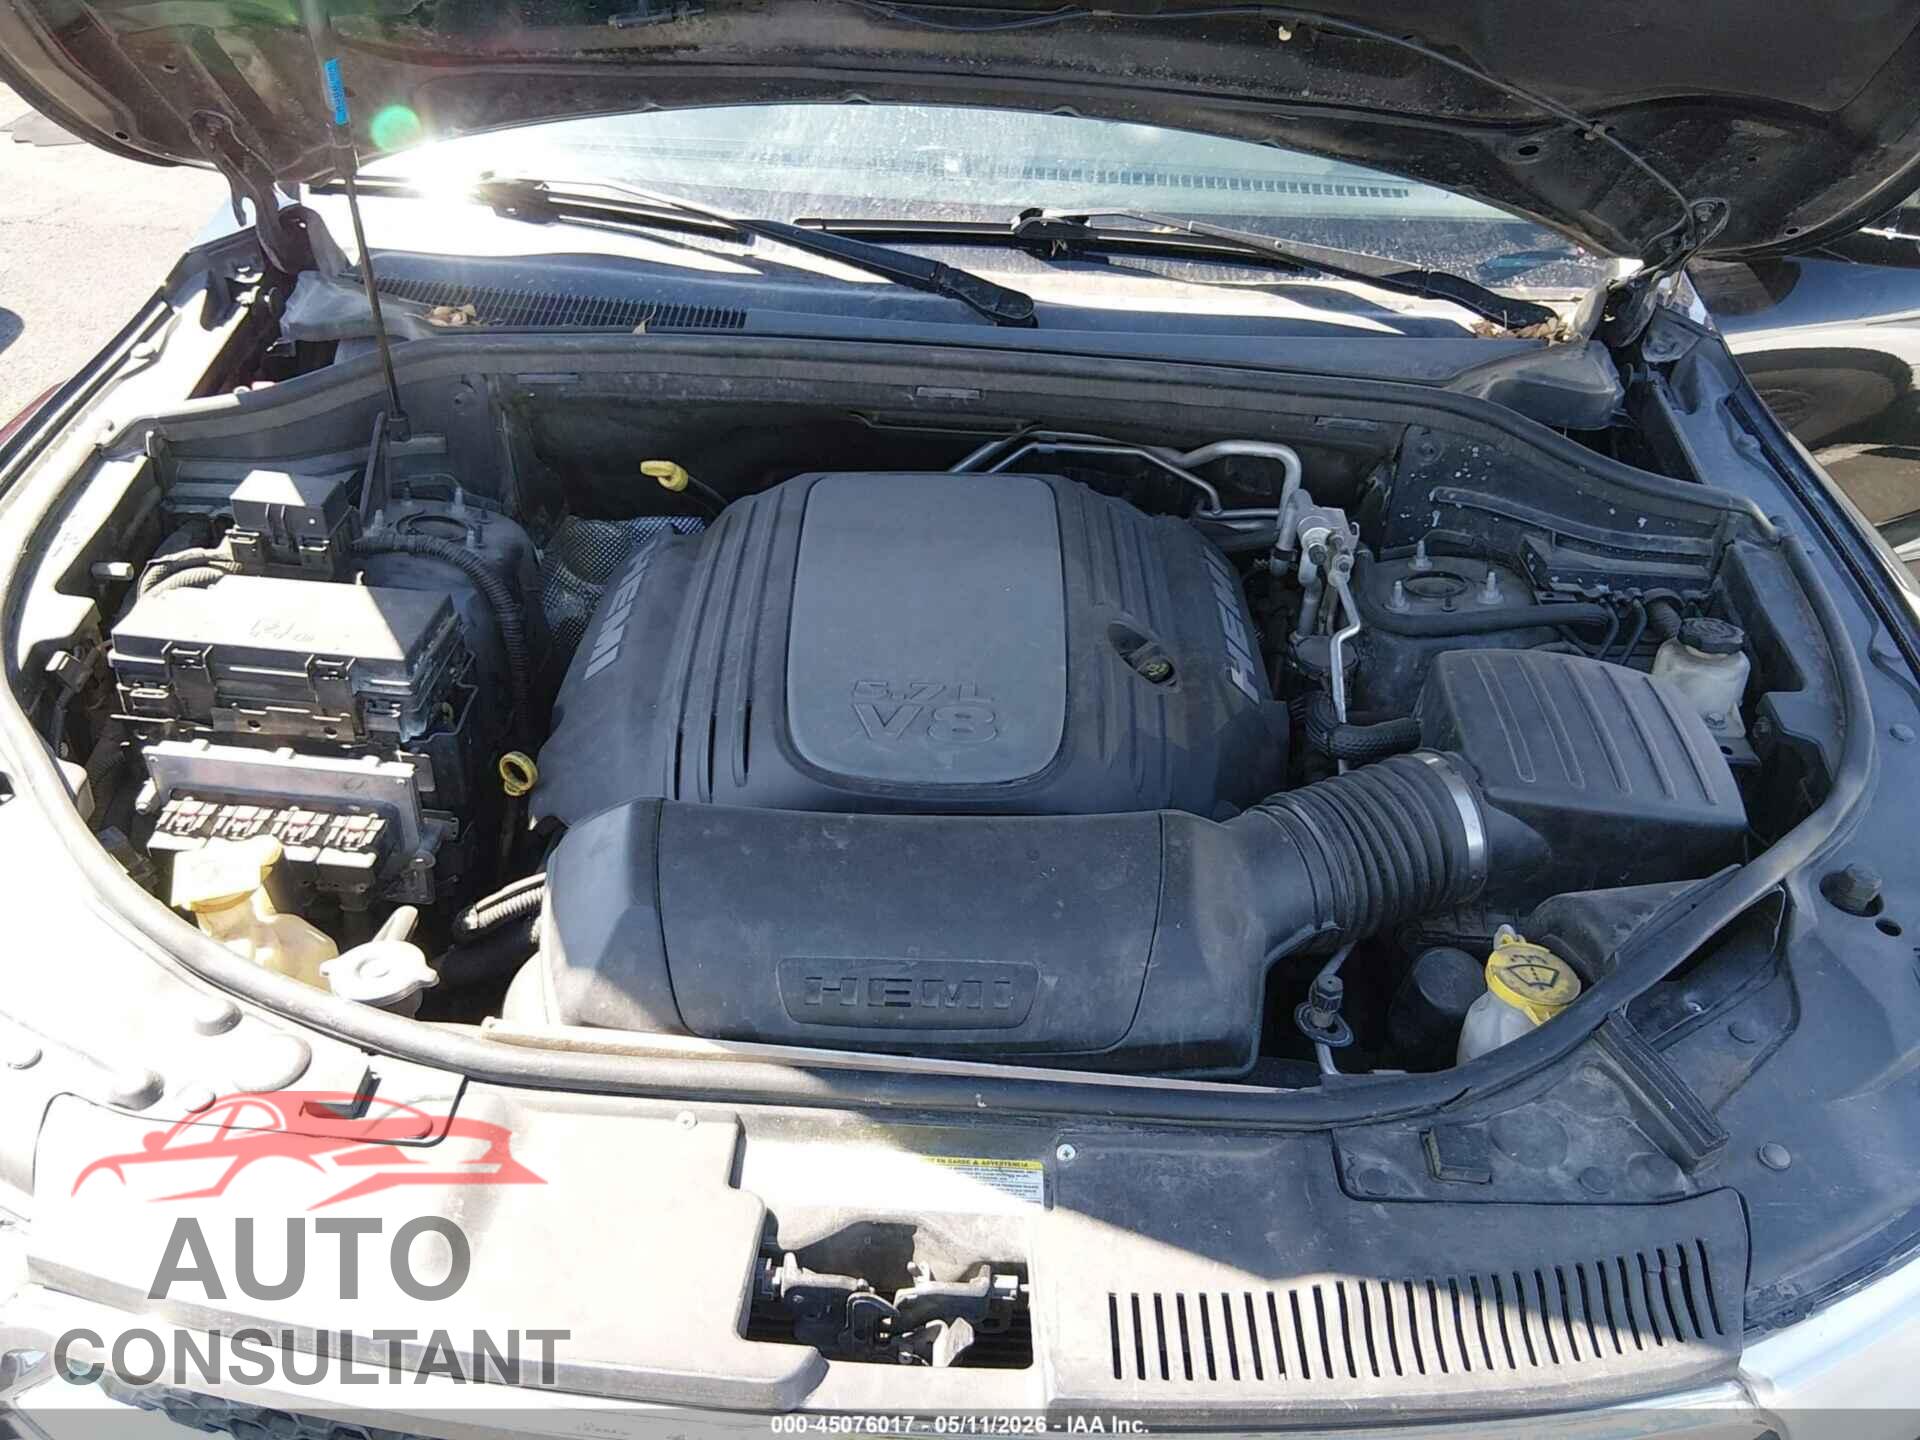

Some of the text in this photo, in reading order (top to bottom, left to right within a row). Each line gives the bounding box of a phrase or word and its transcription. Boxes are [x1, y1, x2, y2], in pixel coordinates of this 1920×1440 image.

[584, 541, 656, 680] HEMI
[1203, 546, 1259, 705] HEMI
[852, 703, 998, 742] V8
[804, 976, 1011, 1009] HEMI
